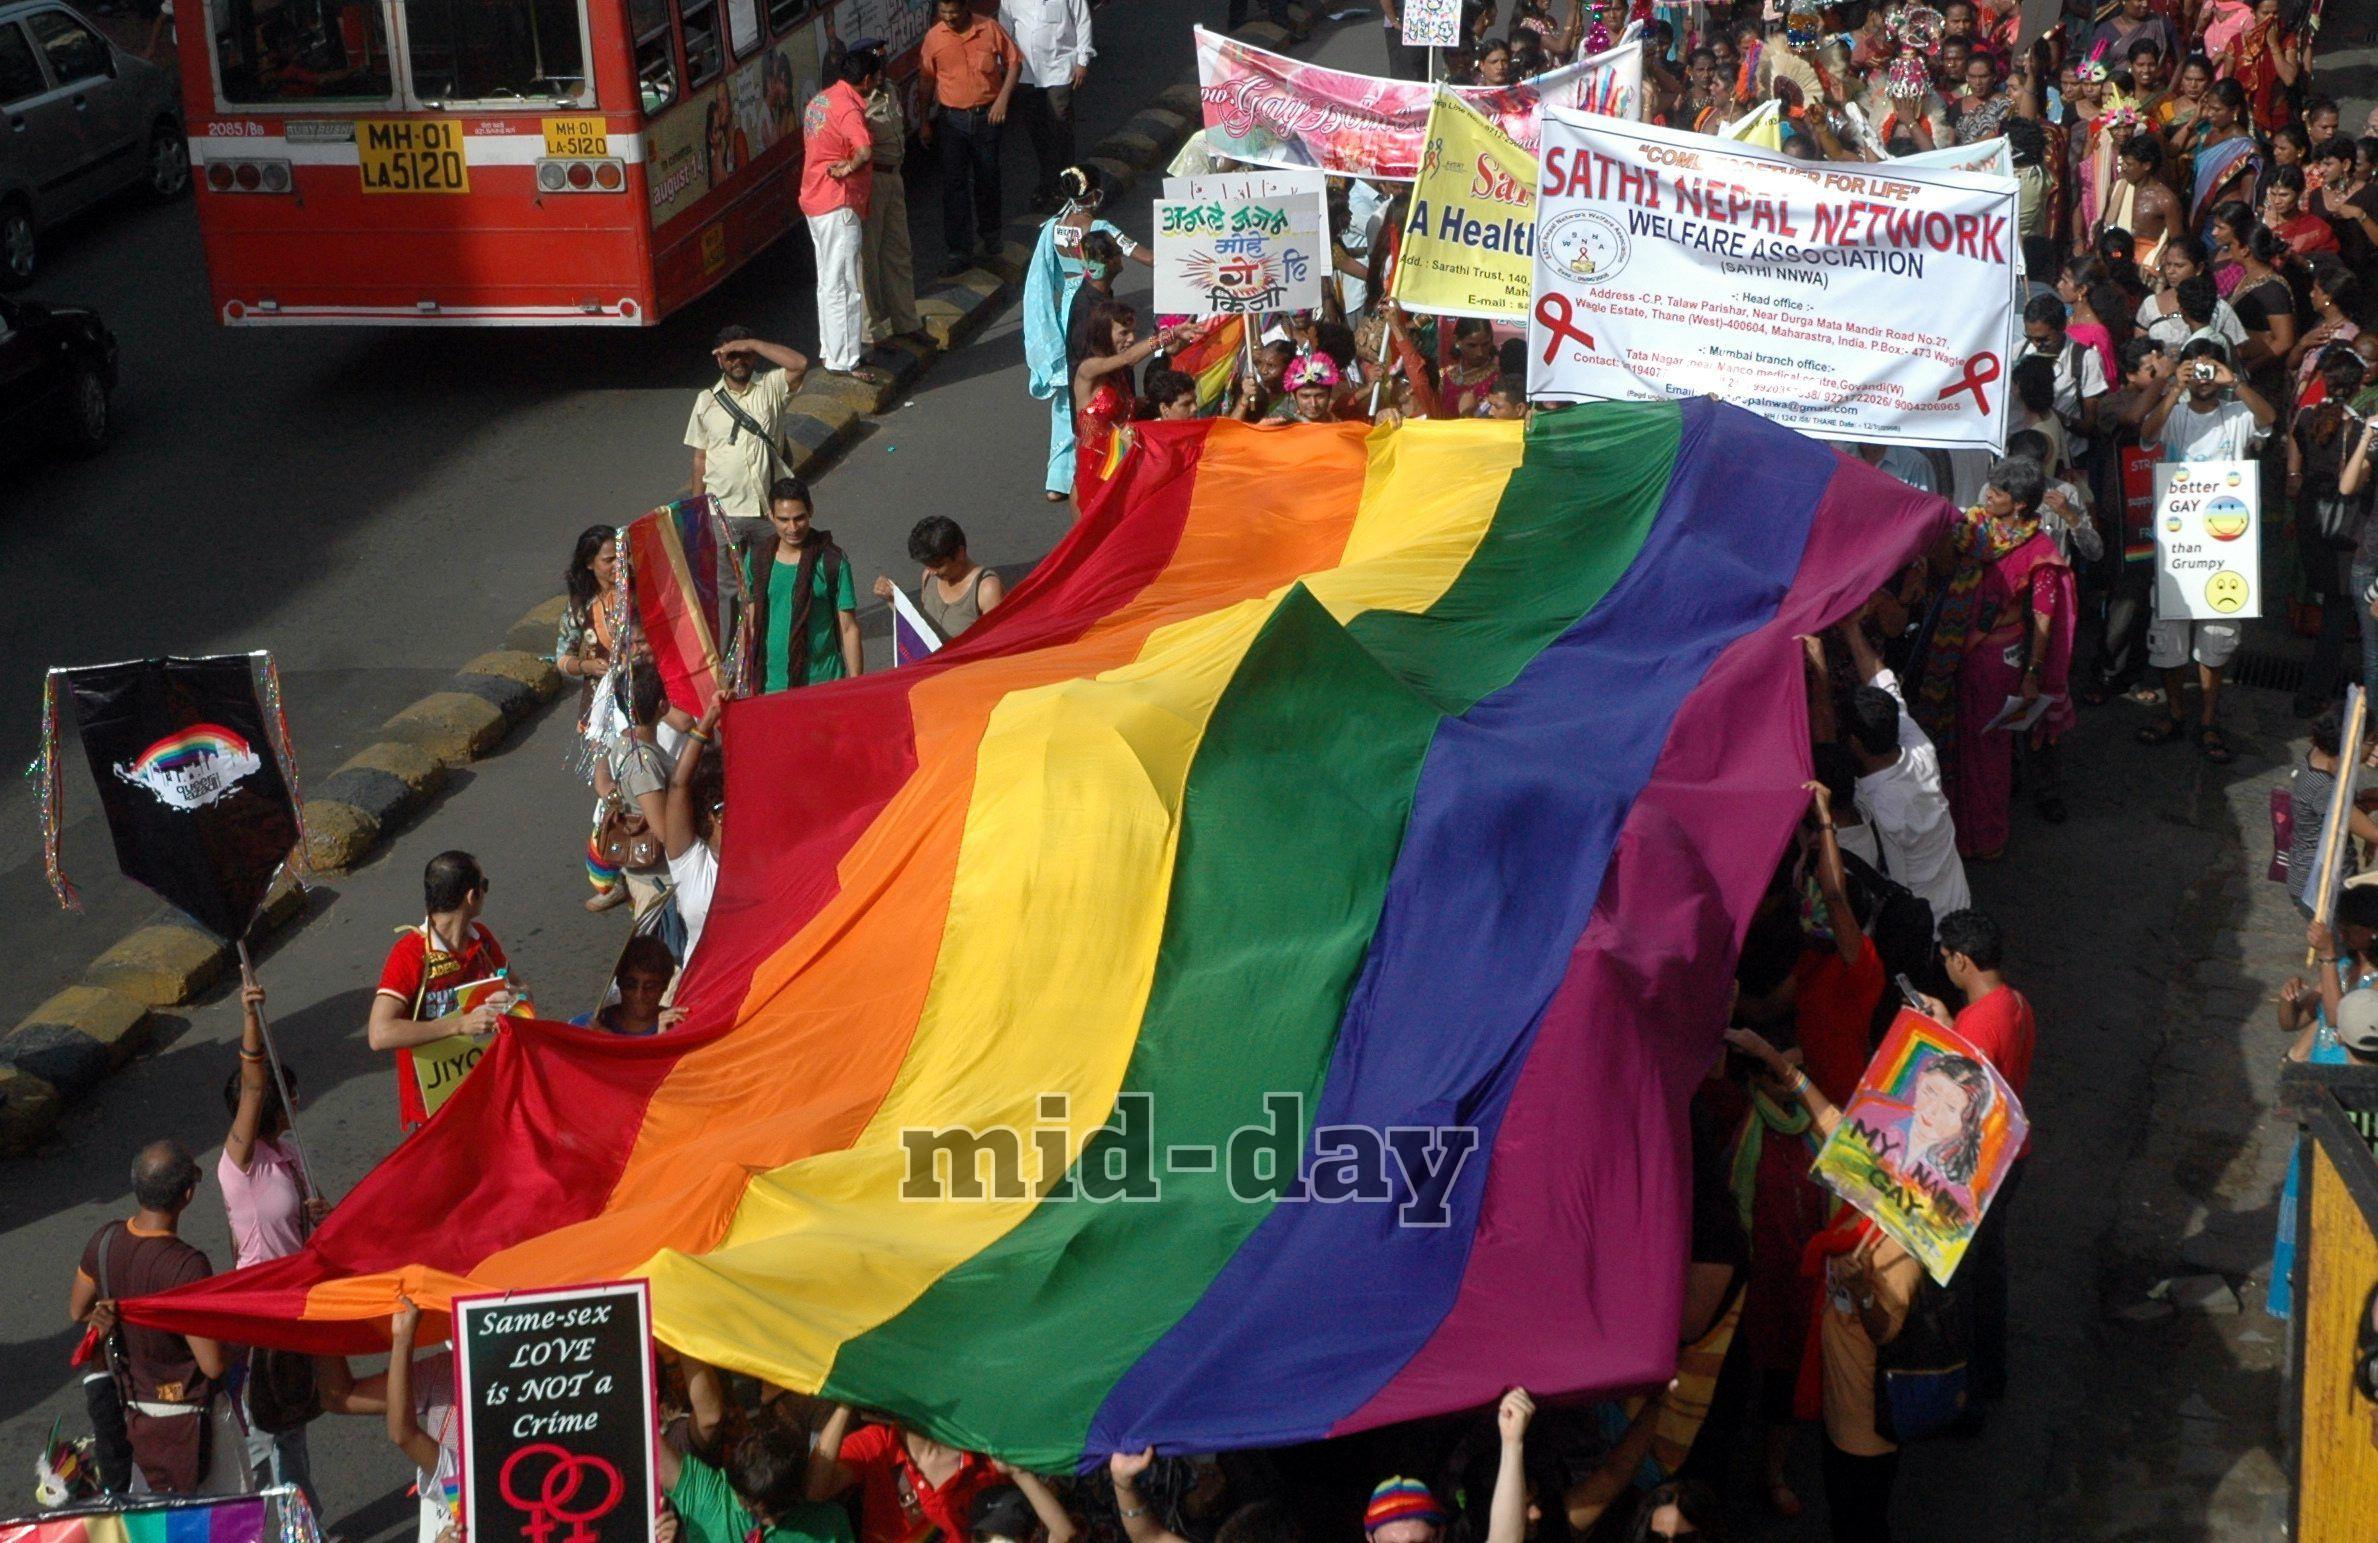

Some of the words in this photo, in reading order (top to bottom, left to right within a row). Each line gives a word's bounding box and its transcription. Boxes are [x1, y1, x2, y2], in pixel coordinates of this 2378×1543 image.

[653, 165, 690, 206] august
[1823, 172, 1865, 195] FOR
[1407, 200, 1428, 236] A
[1542, 146, 1661, 209] SATHI
[1674, 174, 1798, 239] NEPAL
[1810, 200, 2008, 265] NETWORK
[1628, 208, 1747, 260] WELFARE
[1750, 237, 1923, 280] ASSOCIATION
[1432, 260, 1470, 276] Sarathi
[1473, 267, 1505, 282] Trust,
[1720, 262, 1772, 280] (SATHI
[1776, 264, 1829, 291] NNWA)
[1468, 294, 1506, 308] E-mail
[1589, 287, 1636, 303] Address
[1667, 296, 1699, 310] Talaw
[1700, 300, 1749, 318] Parishar,
[1751, 307, 1778, 322] Near
[1781, 312, 1814, 328] Durga
[1817, 318, 1843, 332] Mata
[1845, 321, 1882, 337] Mandir
[1886, 329, 1914, 343] Road
[1742, 292, 1771, 305] Head
[1773, 295, 1803, 311] office
[1575, 297, 1607, 314] Wagle
[1609, 303, 1649, 320] Estate,
[1651, 308, 1685, 323] Thane
[1771, 327, 1836, 346] Maharastra,
[1911, 347, 1931, 359] 473
[1934, 350, 1965, 368] Wagle
[1625, 348, 1649, 361] Tata
[1651, 353, 1684, 367] Nagar
[1709, 345, 1753, 361] Mumbai
[1755, 352, 1794, 368] branch
[2169, 481, 2220, 495] better
[2169, 499, 2201, 514] GAY
[2171, 542, 2202, 554] than
[2171, 558, 2226, 571] Grumpy
[1850, 1116, 1901, 1157] MY
[1868, 1168, 1925, 1217] GAY
[478, 1304, 612, 1336] Same-sex
[508, 1337, 596, 1369] LOVE
[485, 1381, 510, 1407] is
[516, 1369, 594, 1403] NOT
[594, 1374, 614, 1396] a
[512, 1409, 599, 1439] Crime
